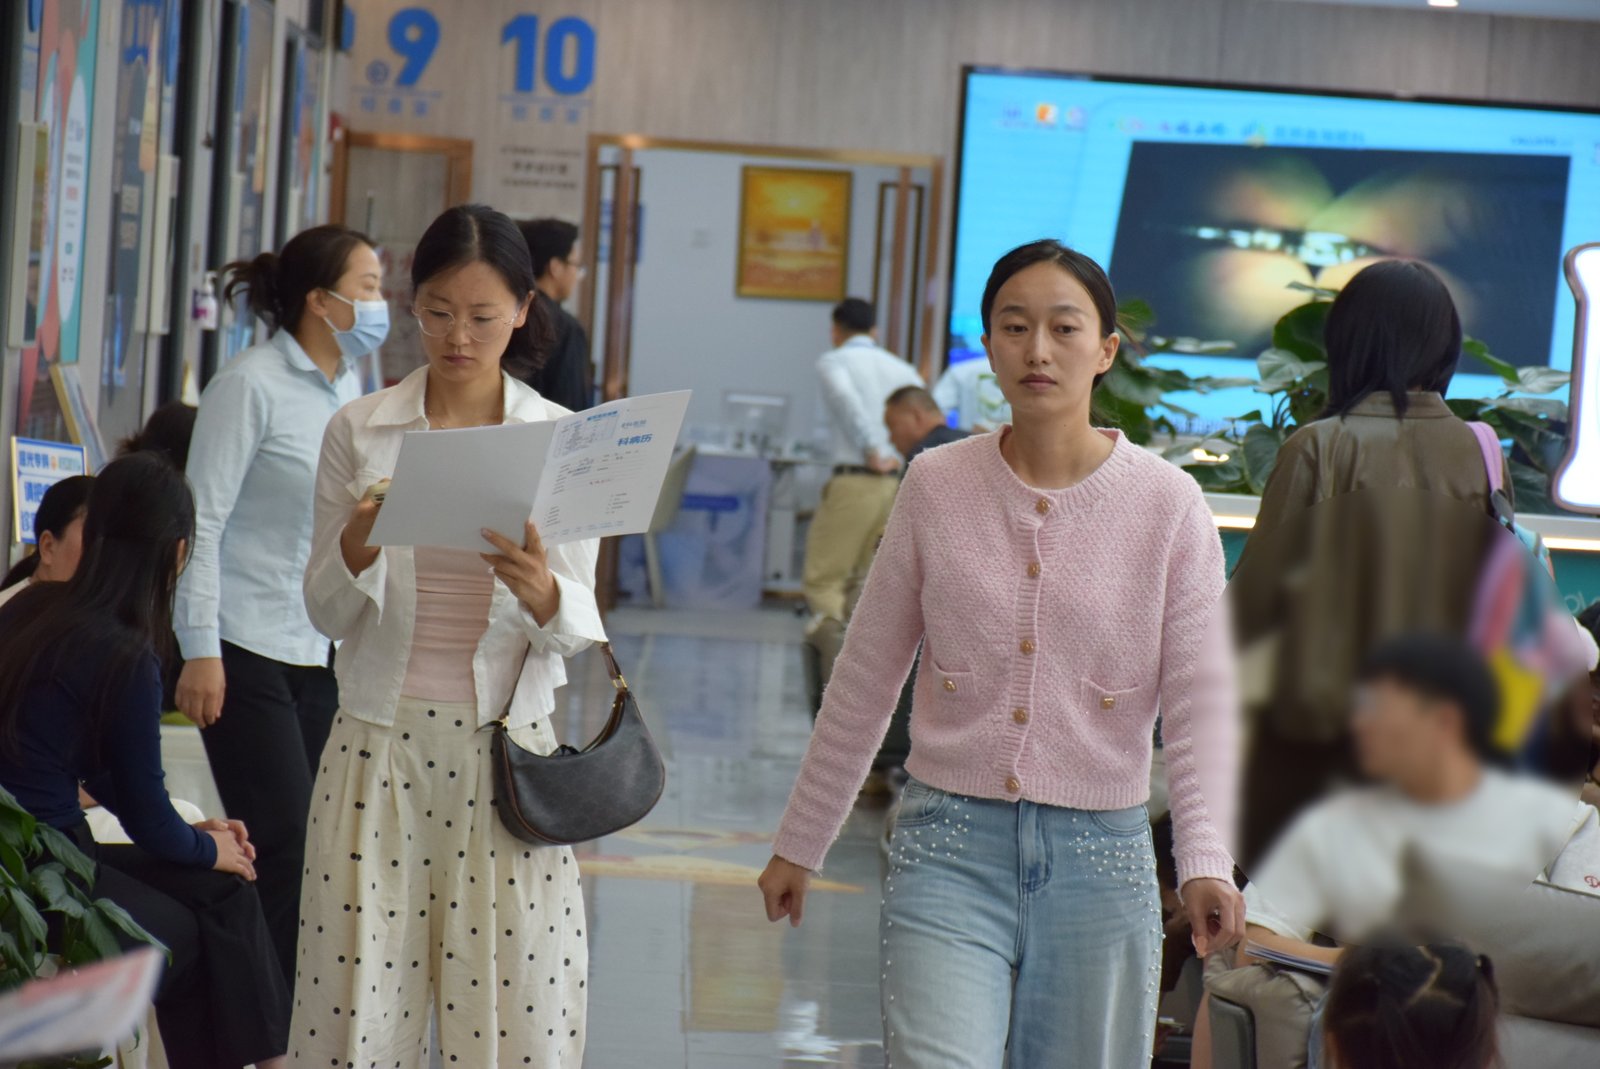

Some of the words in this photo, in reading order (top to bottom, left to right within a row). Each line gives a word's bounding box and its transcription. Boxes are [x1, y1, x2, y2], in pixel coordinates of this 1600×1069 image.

[387, 7, 441, 88] 9
[500, 13, 597, 96] 10
[617, 433, 652, 447] 科病历
